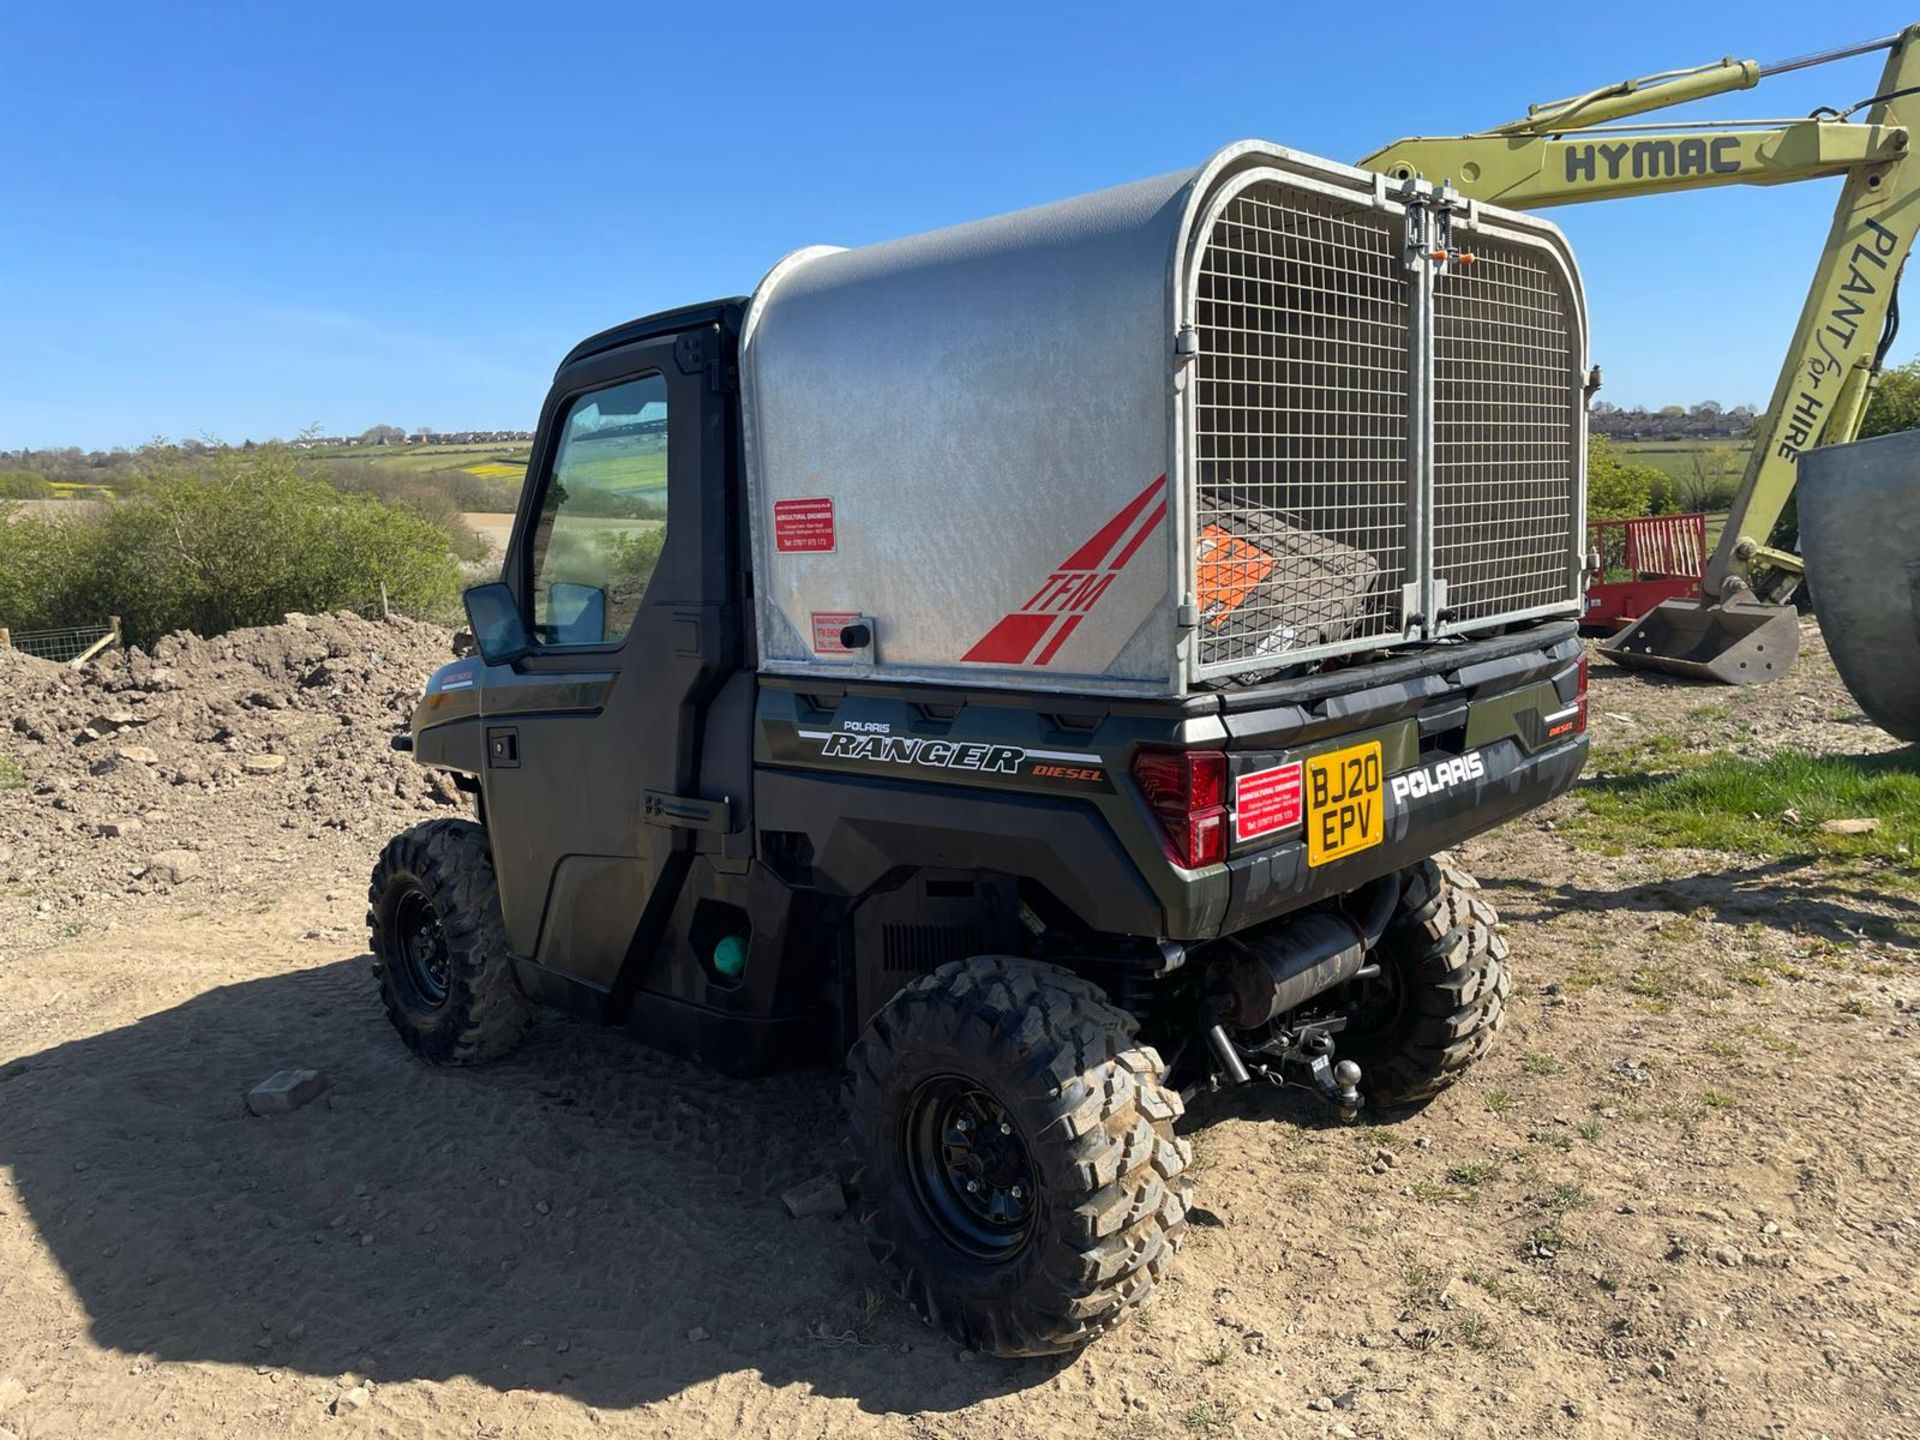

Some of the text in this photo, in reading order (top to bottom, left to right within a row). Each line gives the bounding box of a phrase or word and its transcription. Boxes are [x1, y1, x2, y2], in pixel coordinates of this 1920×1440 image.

[1565, 136, 1741, 182] HYMAC
[1777, 217, 1898, 464] PLANT for HIRE
[1022, 573, 1117, 612] TFM
[844, 720, 890, 733] POLARIS
[822, 732, 1025, 773] RANGER
[1032, 764, 1103, 781] DIESEL
[1312, 753, 1379, 809] BJ20
[1391, 752, 1484, 805] POLARIS
[1323, 799, 1371, 851] EPV
